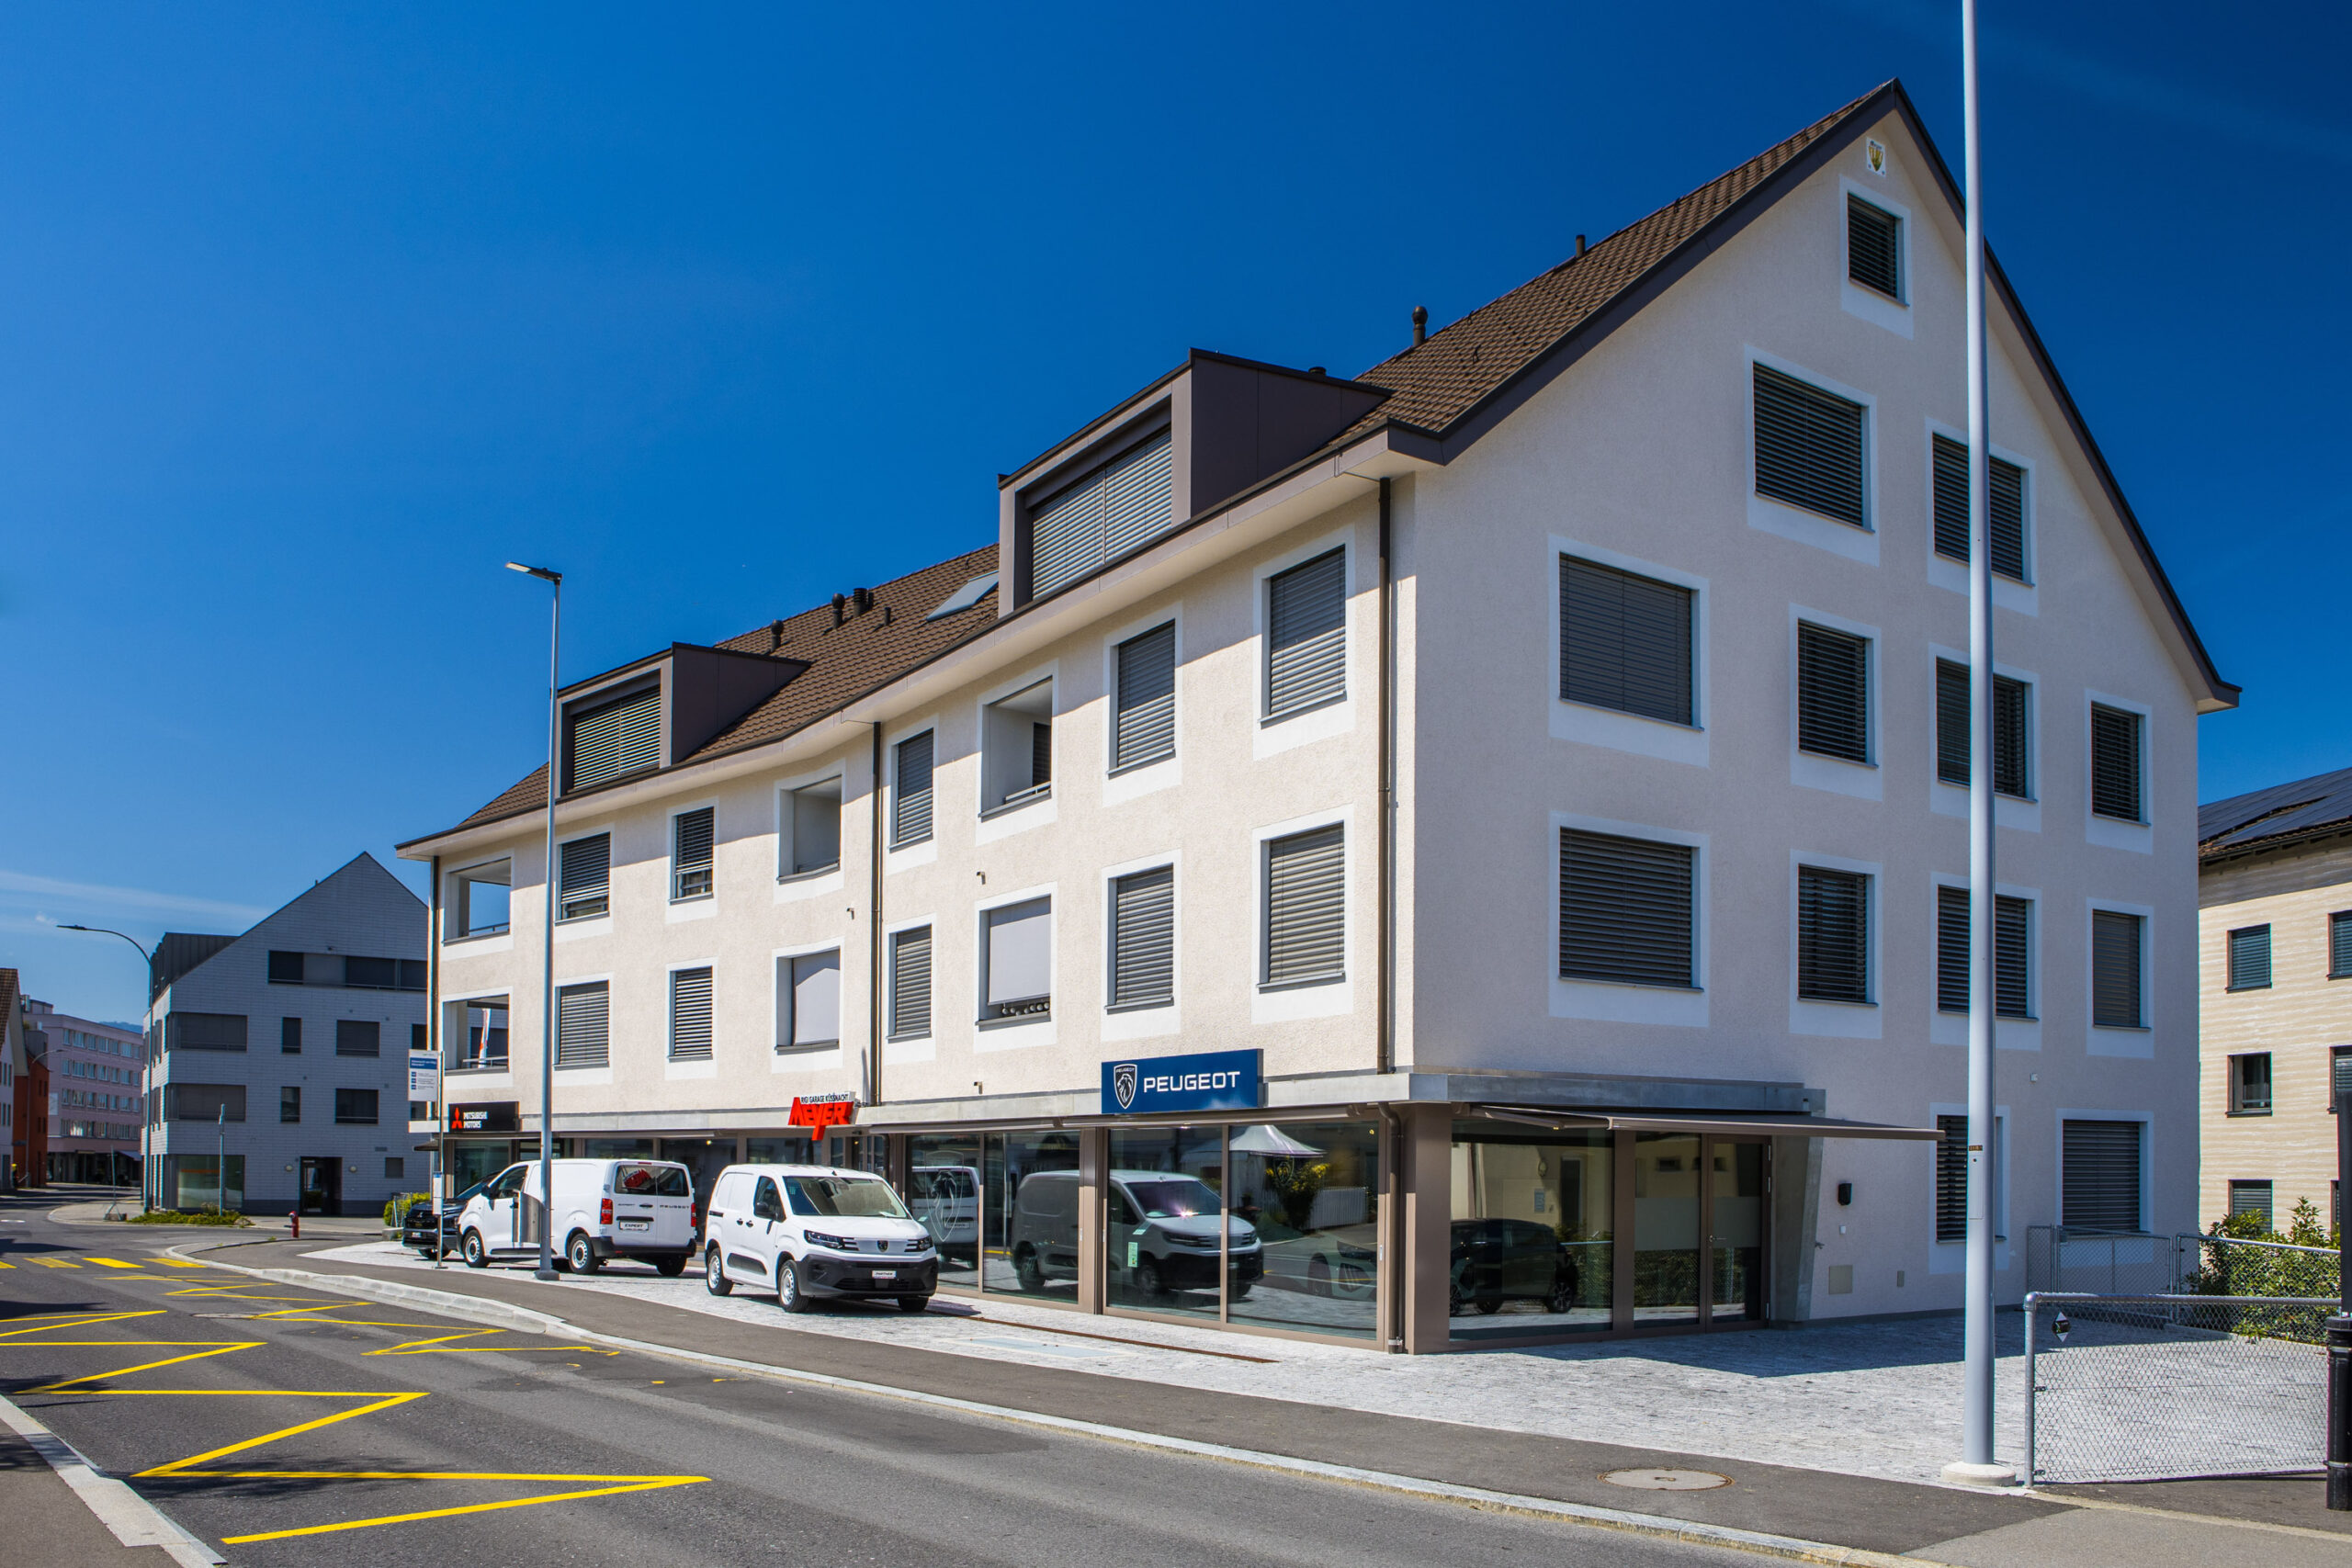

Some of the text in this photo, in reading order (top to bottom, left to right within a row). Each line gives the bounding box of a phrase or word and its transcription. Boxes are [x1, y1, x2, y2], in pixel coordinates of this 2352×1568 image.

[1143, 1071, 1240, 1093] PEUGEOT
[809, 1095, 825, 1103] GARAGE
[463, 1111, 488, 1120] MITSUBISHI
[787, 1097, 853, 1141] MEYER
[463, 1121, 482, 1129] MOTORS
